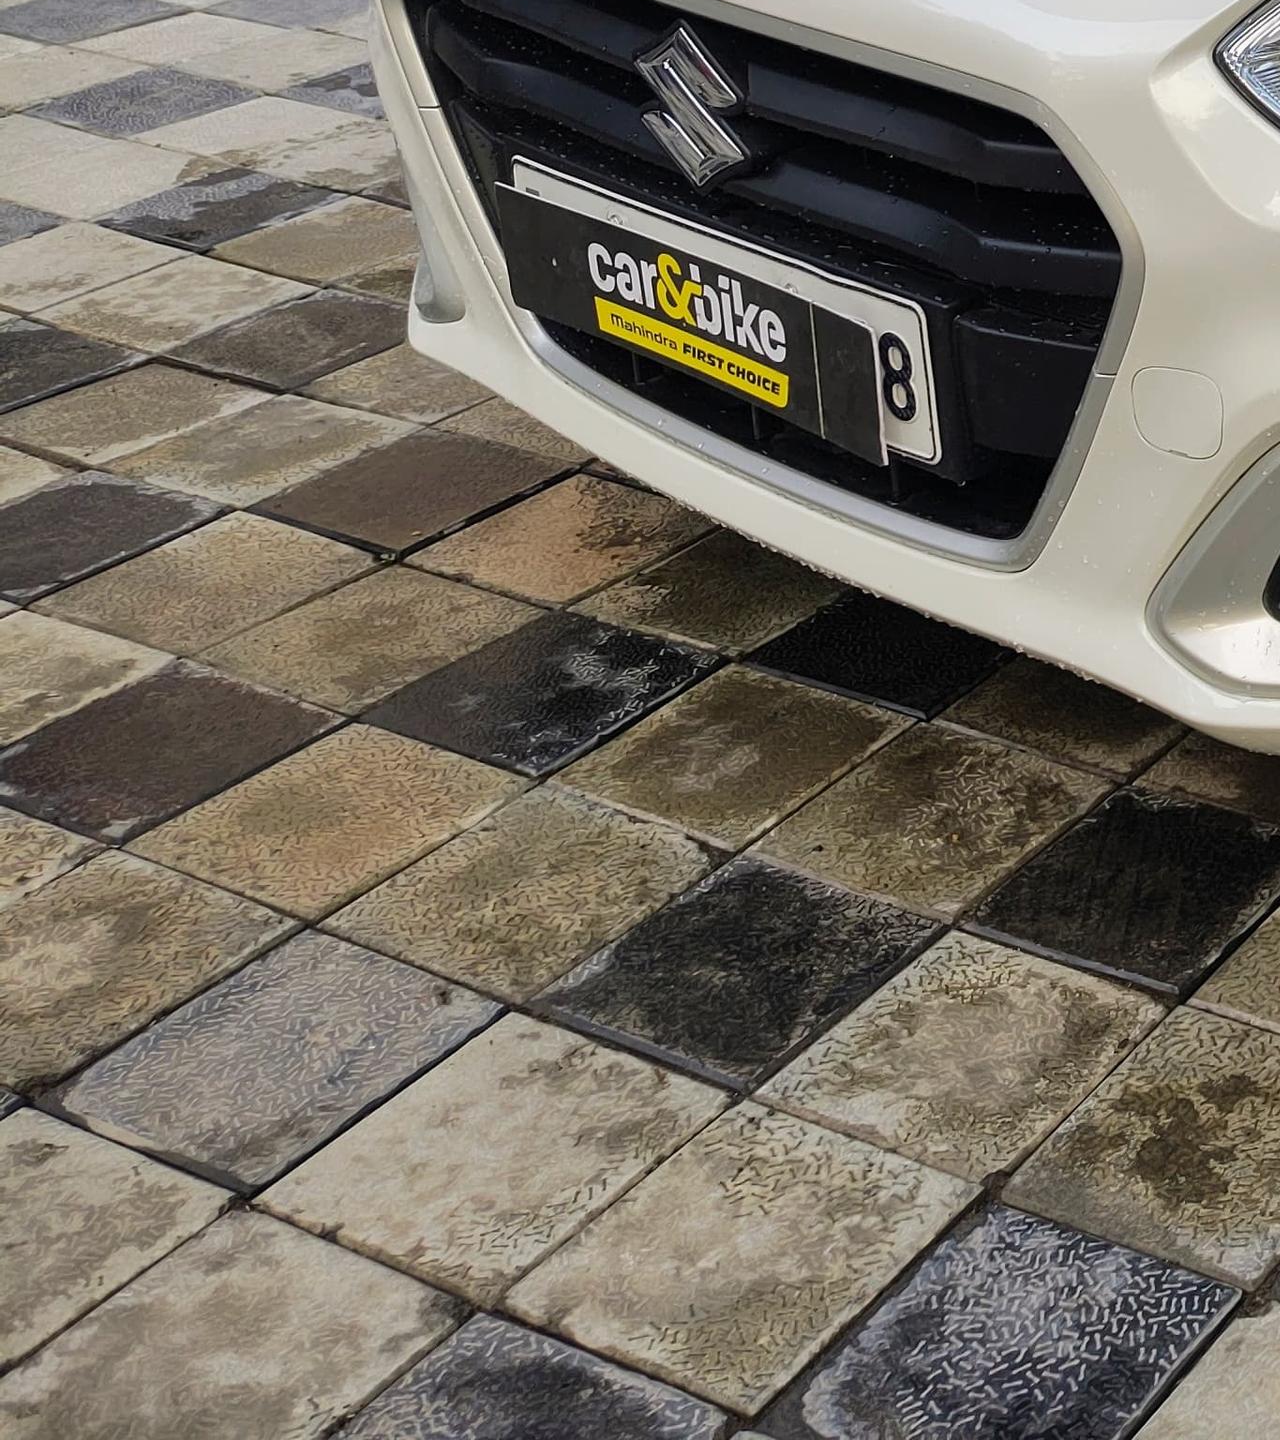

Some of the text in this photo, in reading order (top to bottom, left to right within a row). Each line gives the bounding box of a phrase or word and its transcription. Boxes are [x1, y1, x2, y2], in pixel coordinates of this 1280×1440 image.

[587, 242, 787, 362] car&bike
[610, 313, 781, 396] Mahindra FIRST CHOICE
